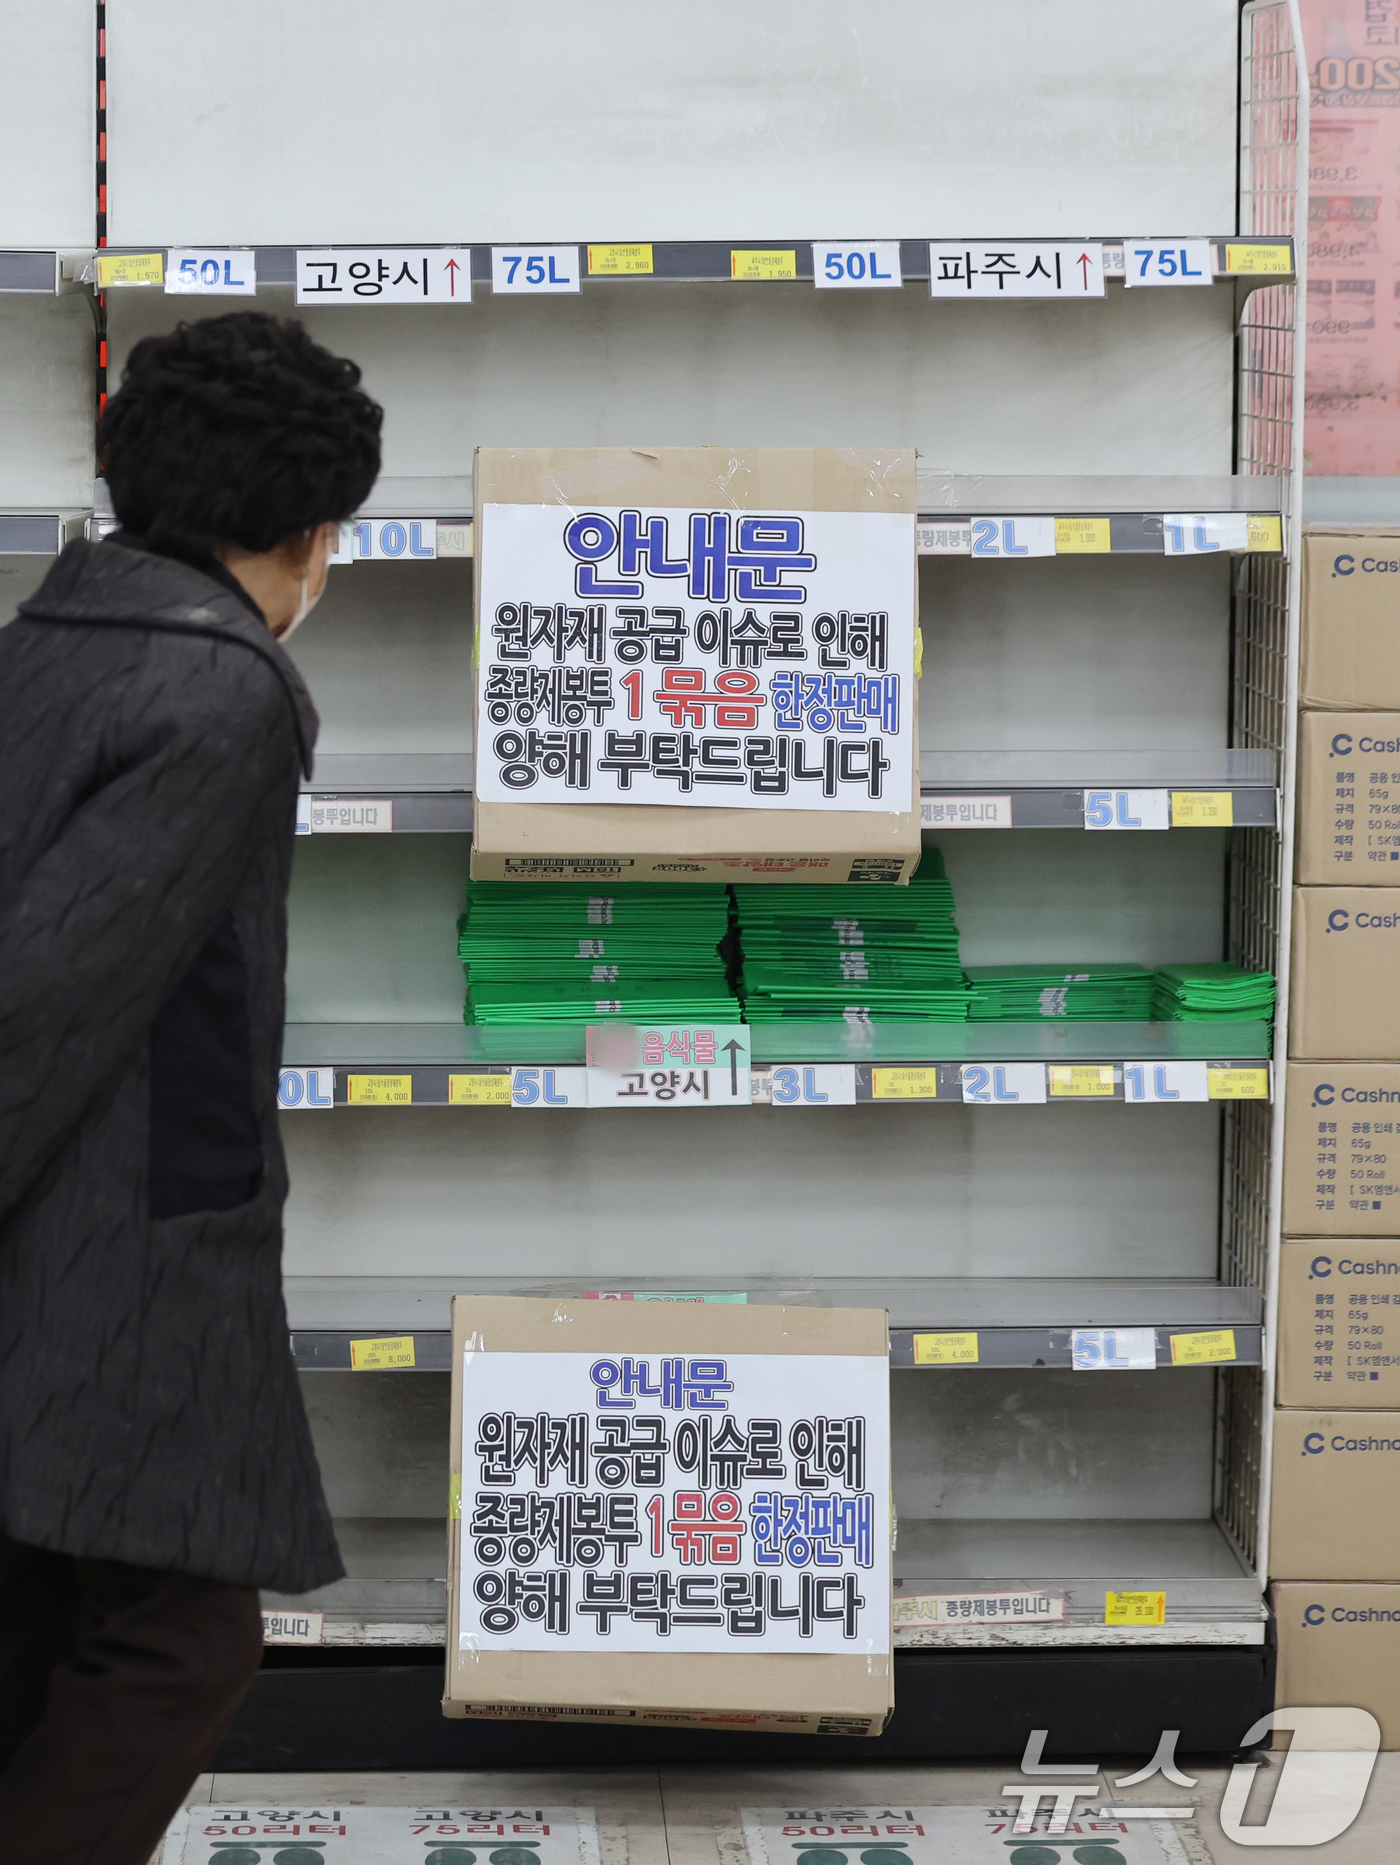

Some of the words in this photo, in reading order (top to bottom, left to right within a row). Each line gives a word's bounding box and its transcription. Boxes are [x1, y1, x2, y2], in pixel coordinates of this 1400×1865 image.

[177, 258, 245, 286] 50L
[302, 257, 430, 297] 고양시
[501, 255, 570, 284] 75L
[824, 252, 892, 280] 50L
[937, 251, 1062, 290] 파주시
[1134, 249, 1203, 277] 75L
[353, 522, 434, 557] 10L
[972, 520, 1028, 555] 2L
[1164, 516, 1219, 551] 1L
[563, 509, 817, 603] 안내문
[1361, 557, 1400, 573] Cas
[492, 602, 607, 663] 원자재
[611, 605, 689, 664] 공급
[695, 608, 807, 668] 이슈로
[812, 610, 890, 671] 인해
[485, 665, 614, 726] 종량제봉투
[770, 671, 900, 734] 한정판매
[493, 729, 591, 789] 양해
[598, 730, 890, 799] 부탁드립니다
[1086, 792, 1142, 828] 5L
[1334, 803, 1355, 814] 규격
[1334, 819, 1355, 830] 수량
[1368, 820, 1382, 830] 50
[1334, 850, 1354, 861] 구분
[640, 1029, 719, 1065] 음식물
[512, 1069, 568, 1106] 5L
[615, 1069, 712, 1102] 고양시
[773, 1067, 829, 1103] 3L
[963, 1067, 1019, 1101] 2L
[1125, 1066, 1180, 1100] 1L
[1316, 1153, 1336, 1164] 규격
[1316, 1168, 1336, 1179] 수량
[1350, 1169, 1364, 1179] 50
[1315, 1200, 1335, 1210] 구분
[1338, 1260, 1400, 1275] Cashn
[1314, 1325, 1334, 1335] 규격
[1073, 1331, 1129, 1367] 5L
[1314, 1340, 1334, 1351] 수량
[1347, 1341, 1361, 1350] 50
[590, 1357, 735, 1411] 안내문
[1313, 1371, 1333, 1381] 구분
[475, 1411, 589, 1488] 원자재
[592, 1414, 671, 1487] 공급
[673, 1415, 786, 1490] 이슈로
[789, 1416, 866, 1491] 인해
[470, 1491, 642, 1567] 종량제봉투
[750, 1491, 875, 1569] 한정판매
[473, 1568, 571, 1636] 양해
[577, 1570, 866, 1639] 부탁드립니다
[946, 1597, 1051, 1618] 종량제봉투입니다
[211, 1808, 341, 1823] 고양시
[413, 1808, 543, 1823] 고양시
[785, 1809, 915, 1822] 파주시
[984, 1821, 1130, 1834] 75리터
[202, 1823, 347, 1837] 50리터
[408, 1823, 551, 1837] 75리터
[781, 1824, 926, 1837] 50리터
